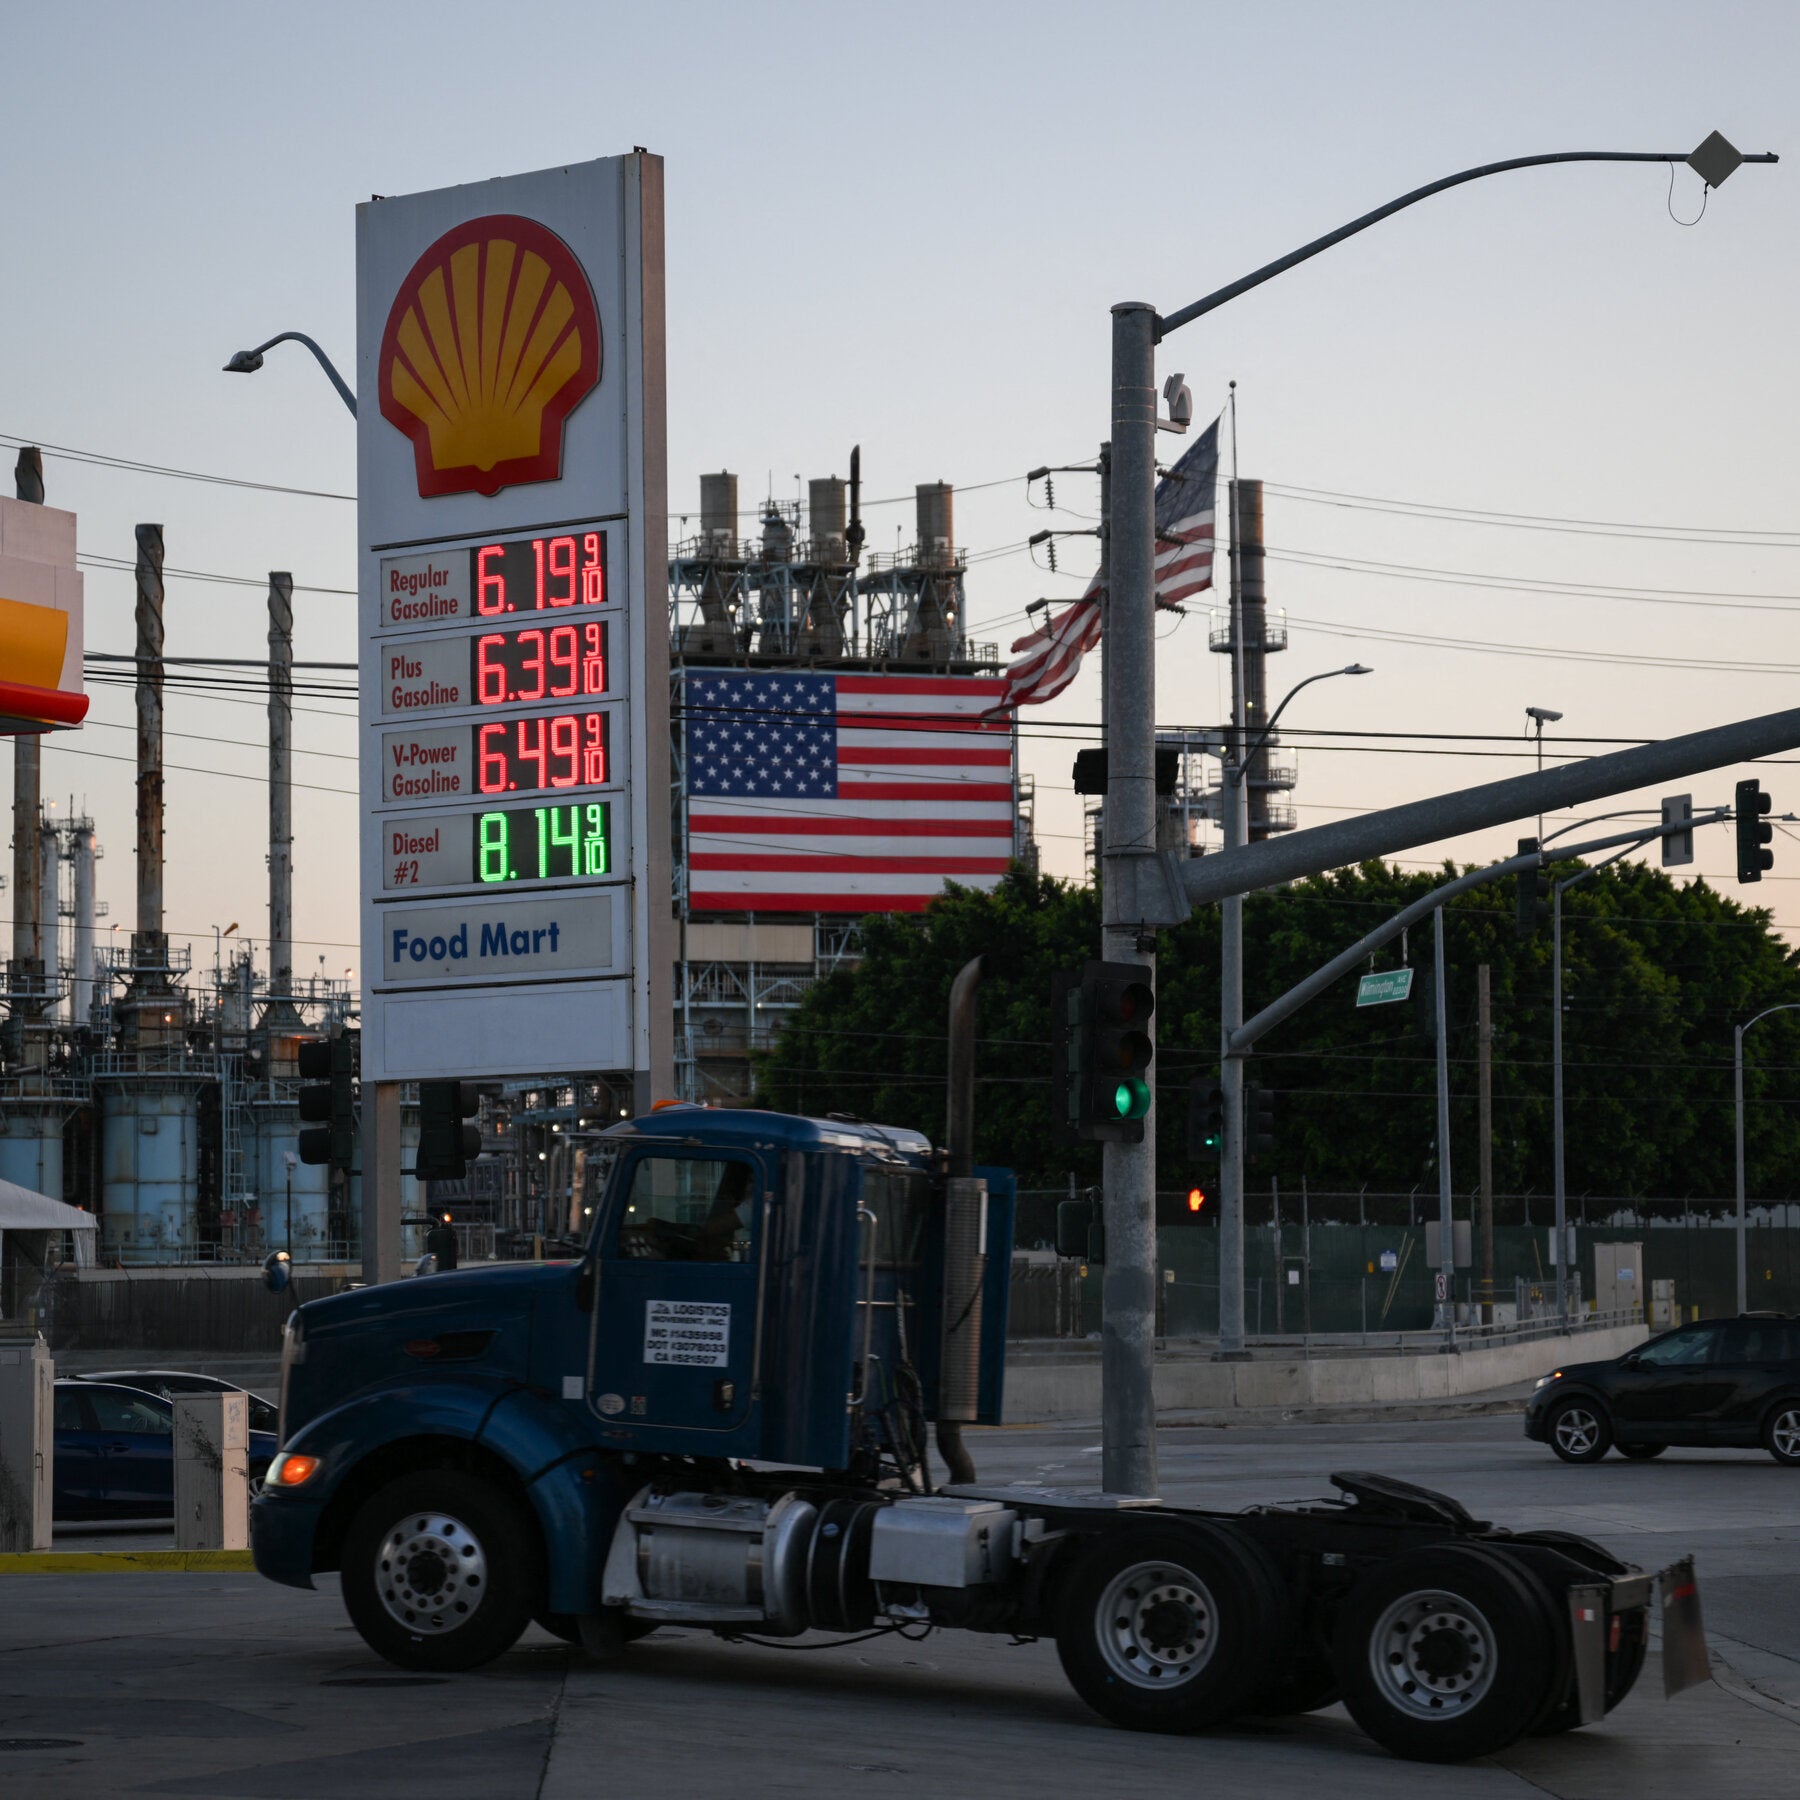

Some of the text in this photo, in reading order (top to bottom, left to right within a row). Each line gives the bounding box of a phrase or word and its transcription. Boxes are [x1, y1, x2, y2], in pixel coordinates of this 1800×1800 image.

[390, 564, 449, 596] Regular
[477, 536, 576, 616] 6.19
[390, 597, 458, 621] Gasoline
[391, 657, 423, 680] Plus
[478, 626, 577, 705] 6.39
[391, 685, 459, 708] Gasoline
[392, 744, 457, 767] V-Power
[479, 716, 578, 793] 6.49
[392, 773, 460, 796] Gasoline
[393, 829, 439, 855] Diesel
[480, 805, 579, 882] 8.14
[394, 861, 418, 884] #2
[393, 922, 560, 962] Food Mart
[1361, 980, 1394, 998] Wilmington
[673, 1304, 728, 1316] LOGISTICS
[647, 1340, 668, 1349] DOT
[654, 1352, 669, 1362] CA
